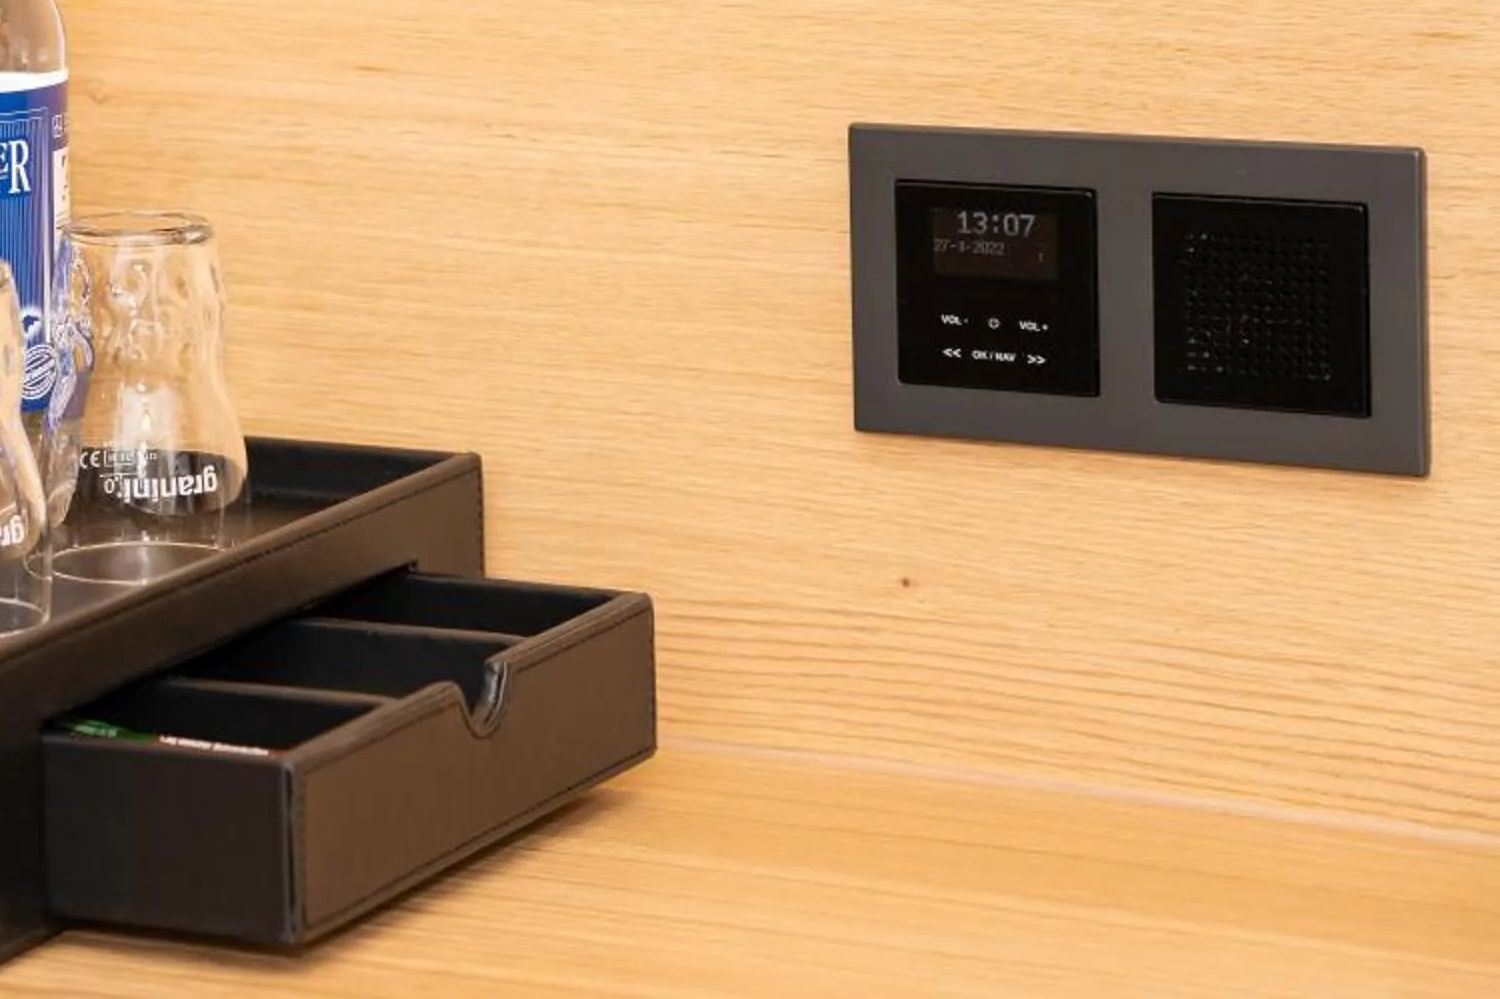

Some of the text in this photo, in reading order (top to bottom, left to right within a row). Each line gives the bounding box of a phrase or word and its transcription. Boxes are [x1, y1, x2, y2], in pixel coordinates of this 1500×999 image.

[957, 210, 1037, 238] 13:07
[940, 314, 962, 326] VOL
[1019, 320, 1041, 332] VOL
[123, 464, 219, 504] granini
